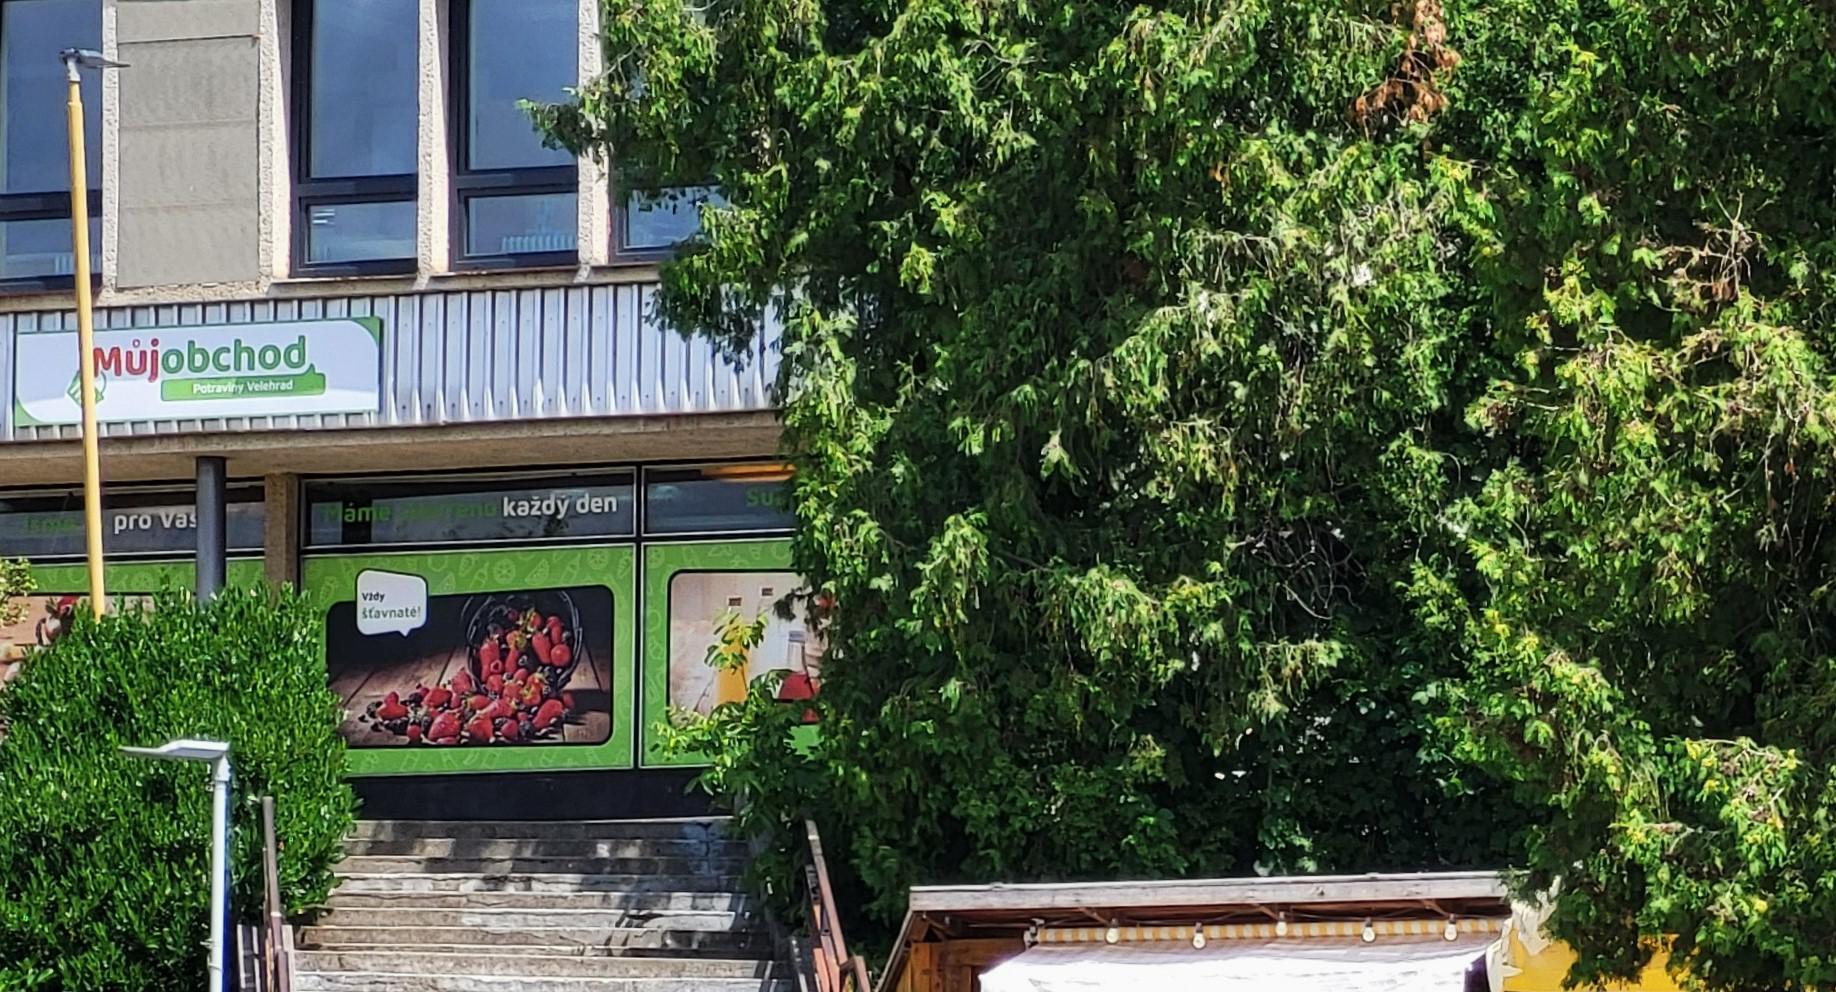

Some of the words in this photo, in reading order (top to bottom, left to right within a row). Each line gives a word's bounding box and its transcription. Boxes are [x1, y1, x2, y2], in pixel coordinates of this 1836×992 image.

[192, 383, 245, 395] Potraviny
[247, 379, 294, 393] Velehrad
[503, 495, 567, 519] každý
[576, 494, 617, 512] den
[114, 514, 151, 534] pro
[362, 592, 385, 603] Vždy
[362, 606, 421, 619] šťavnaté!
